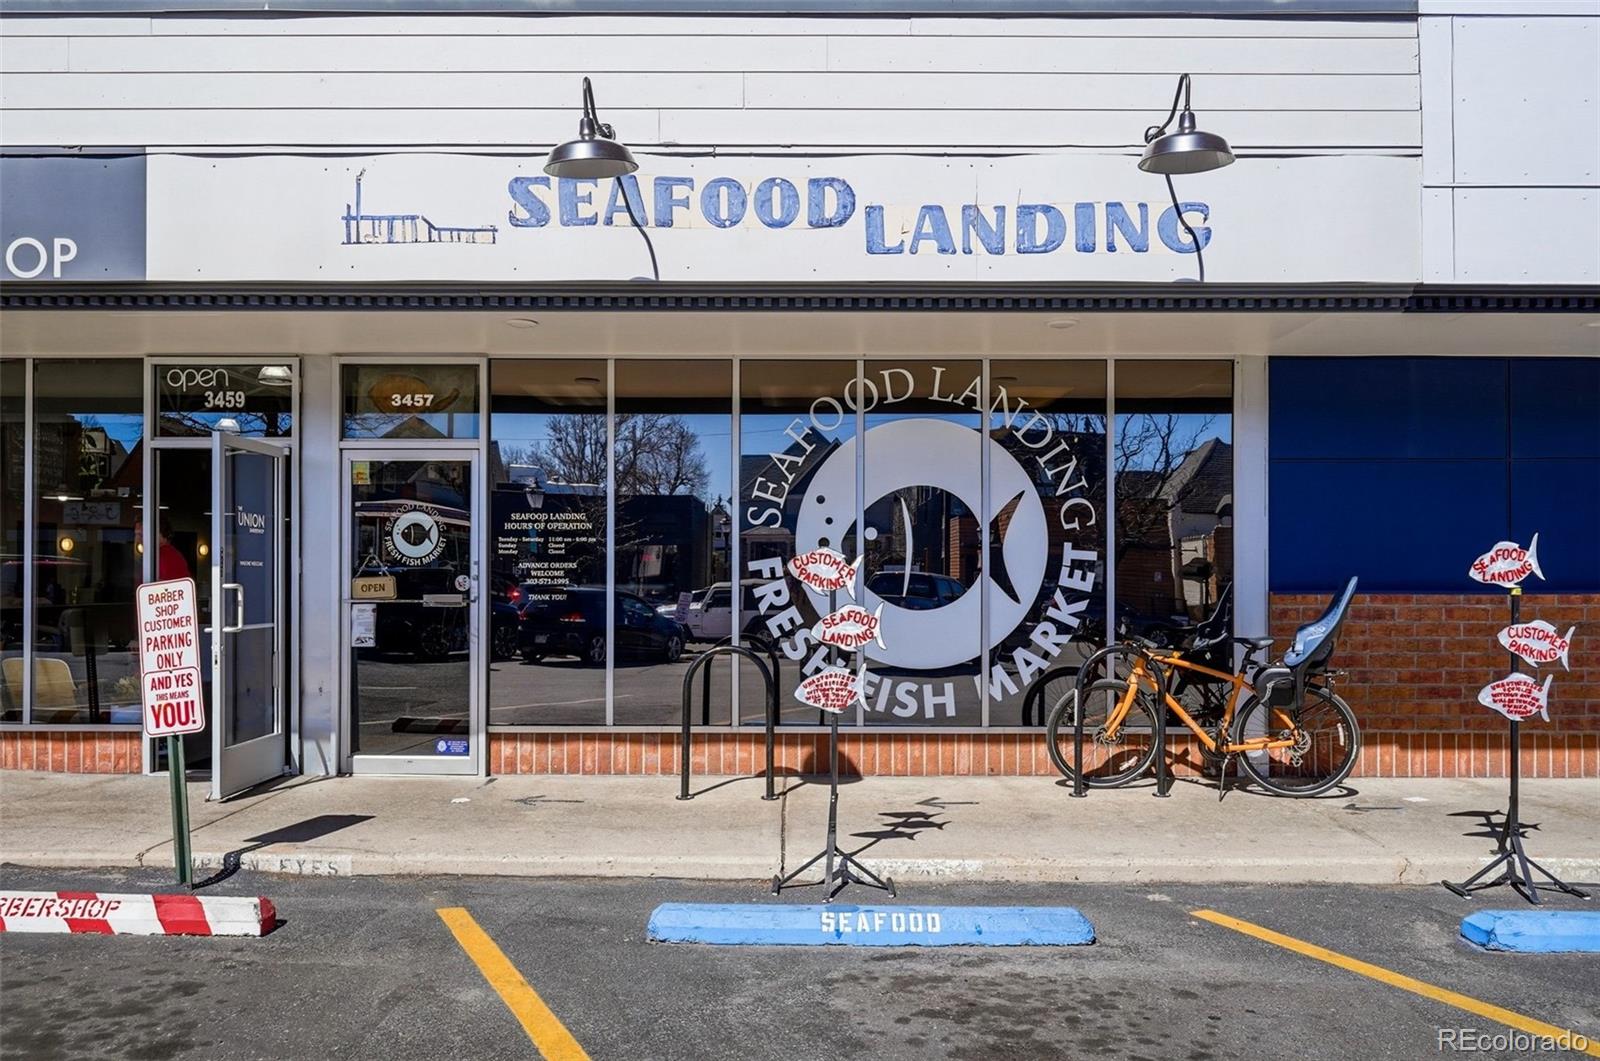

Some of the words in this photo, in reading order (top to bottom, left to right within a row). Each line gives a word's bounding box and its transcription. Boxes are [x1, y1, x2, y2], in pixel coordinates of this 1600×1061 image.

[508, 176, 856, 229] SEAFOOD
[865, 202, 1212, 254] LANDING
[6, 237, 78, 278] OP
[167, 369, 229, 392] open
[204, 391, 246, 408] 3459
[391, 394, 434, 407] 3457
[747, 368, 915, 528] SEAFOOD
[928, 366, 1096, 531] LANDING
[238, 512, 265, 528] UNION
[504, 522, 533, 530] HOURS
[534, 522, 545, 530] OF
[547, 522, 593, 530] OPERATION
[385, 536, 403, 561] FRESH
[401, 556, 421, 566] FISH
[421, 537, 447, 565] MARKET
[1473, 548, 1526, 573] SEAFOOD
[793, 552, 856, 581] CUSTOMER
[1481, 560, 1533, 582] LANDING
[361, 583, 385, 593] OPEN
[798, 568, 846, 590] PARKING
[148, 589, 184, 605] BARBER
[155, 604, 179, 617] SHOP
[822, 610, 878, 630] SEAFOOD
[144, 615, 192, 633] CUSTOMER
[974, 542, 1098, 702] MARKET
[146, 632, 192, 652] PARKING
[822, 628, 874, 648] LANDING
[1507, 626, 1567, 652] CUSTOMER
[156, 652, 184, 669] ONLY
[1509, 640, 1557, 662] PARKING
[150, 675, 172, 691] AND
[174, 673, 193, 687] YES
[156, 692, 168, 700] THIS
[169, 690, 189, 700] MEANS
[150, 701, 196, 728] YOU!
[821, 912, 941, 934] SEAFOOD
